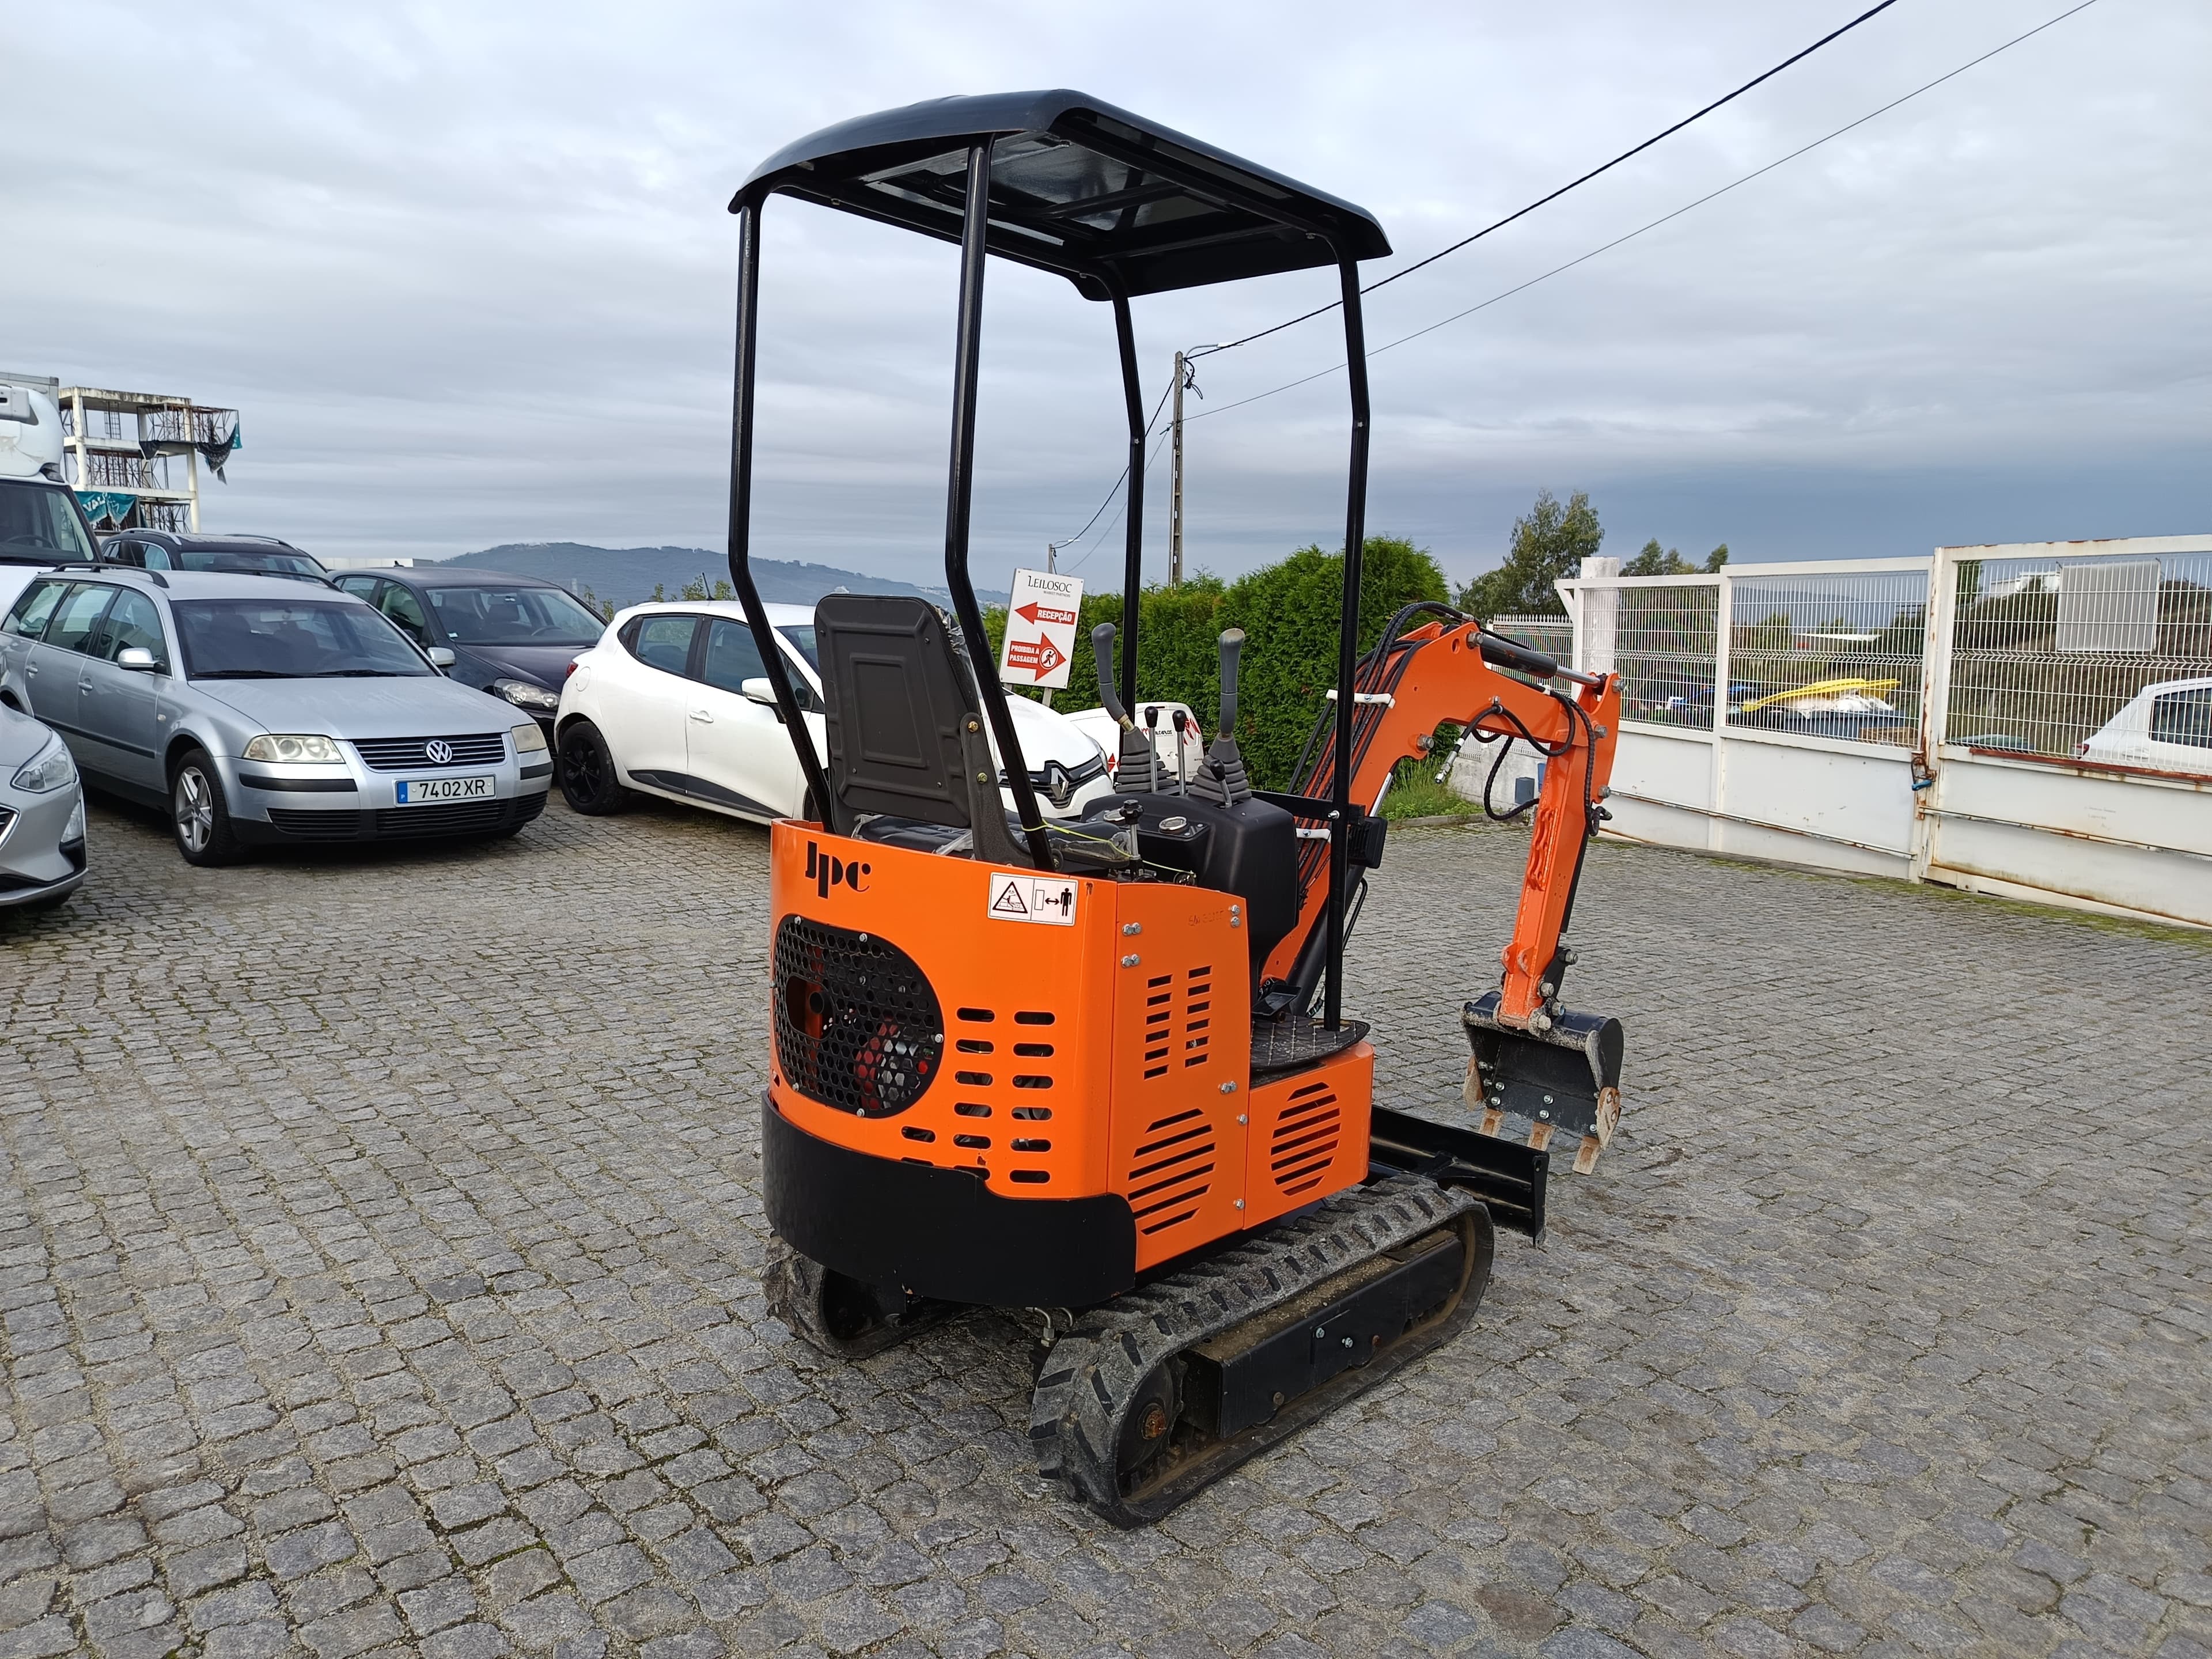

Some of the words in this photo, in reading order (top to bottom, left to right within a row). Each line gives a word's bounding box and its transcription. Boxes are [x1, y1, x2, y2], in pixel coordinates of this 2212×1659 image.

[1028, 575, 1072, 593] LEILOSOC
[1037, 609, 1072, 623] RECEPÇÃO
[1011, 645, 1035, 654] PROIBIDA
[1009, 654, 1039, 664] PASSAGEM
